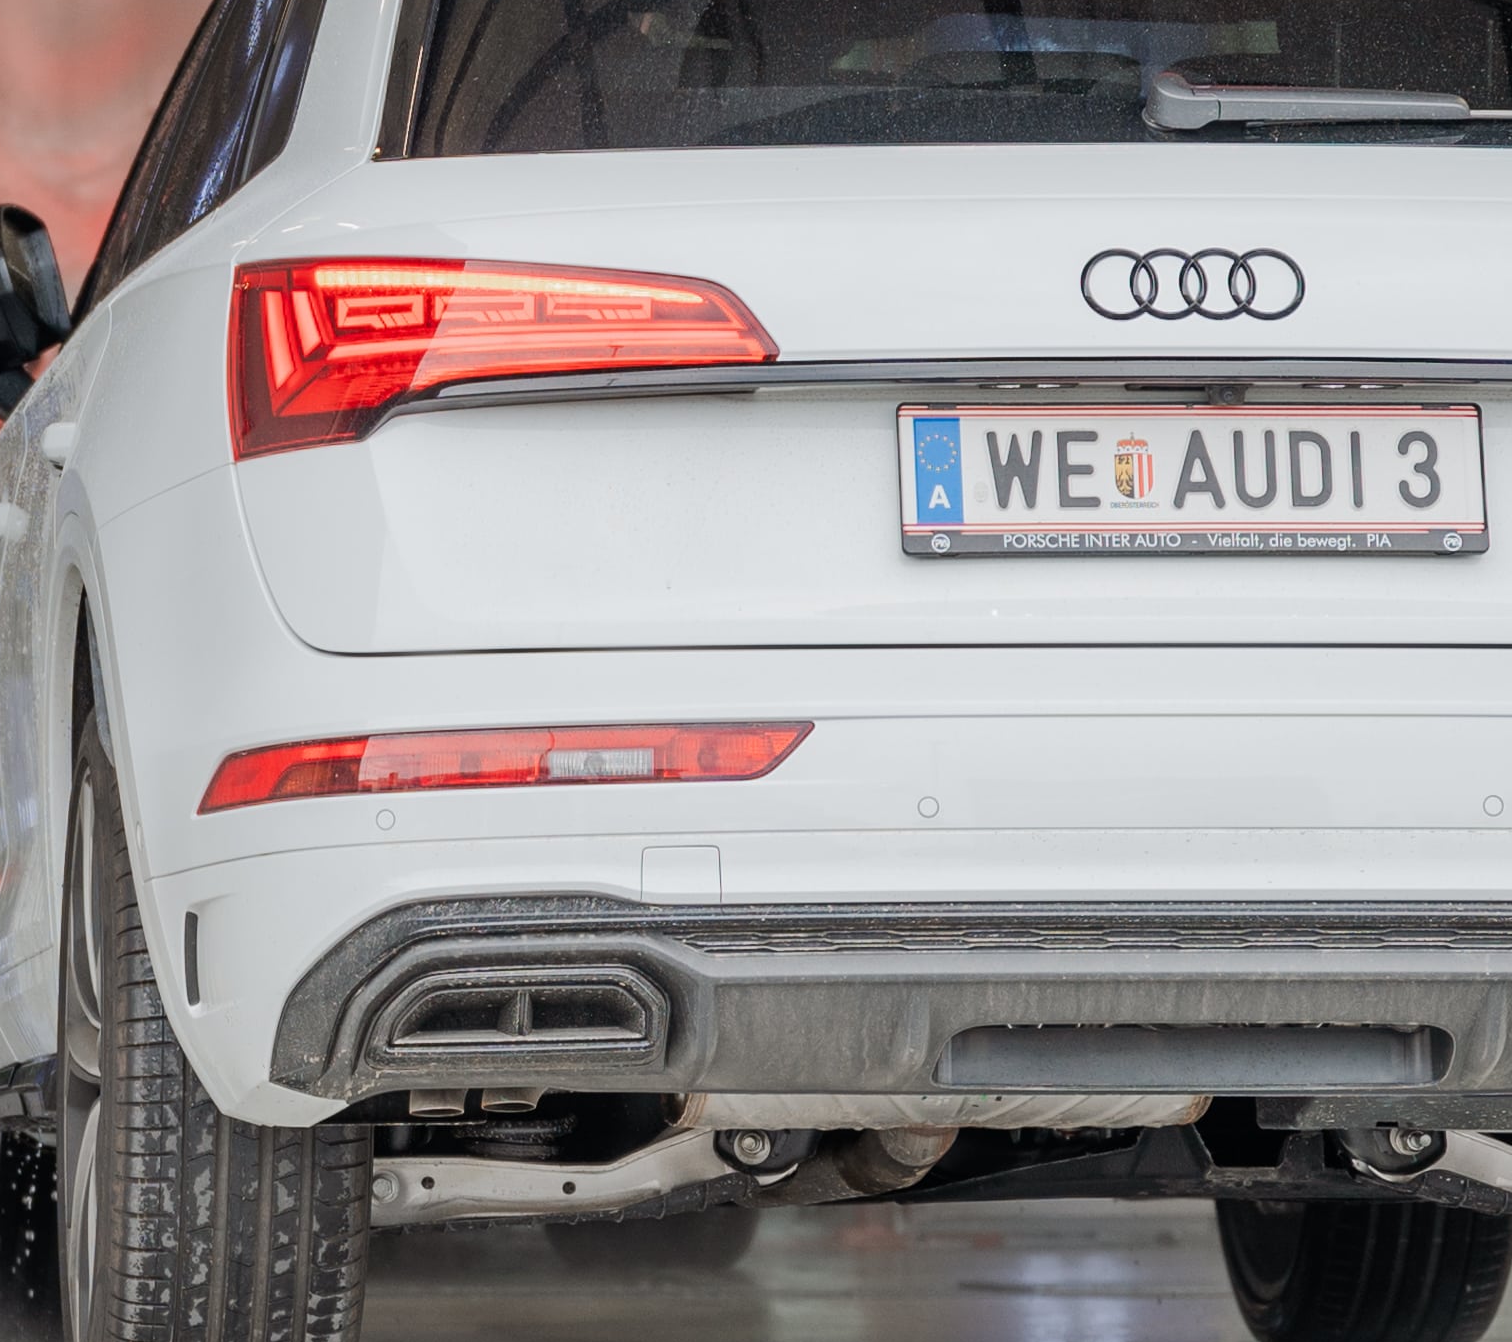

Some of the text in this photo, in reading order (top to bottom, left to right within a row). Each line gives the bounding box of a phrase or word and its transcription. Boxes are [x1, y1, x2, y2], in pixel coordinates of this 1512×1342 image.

[986, 429, 1441, 509] WE AUDI 3
[928, 484, 951, 509] A
[1003, 534, 1080, 548] PORSCHE
[1085, 534, 1133, 548] INTER
[1136, 534, 1182, 548] AUTO
[1208, 533, 1264, 549] Vielfalt,
[1269, 533, 1291, 548] die
[1293, 533, 1356, 551] bewegt.
[1367, 534, 1392, 548] PIA
